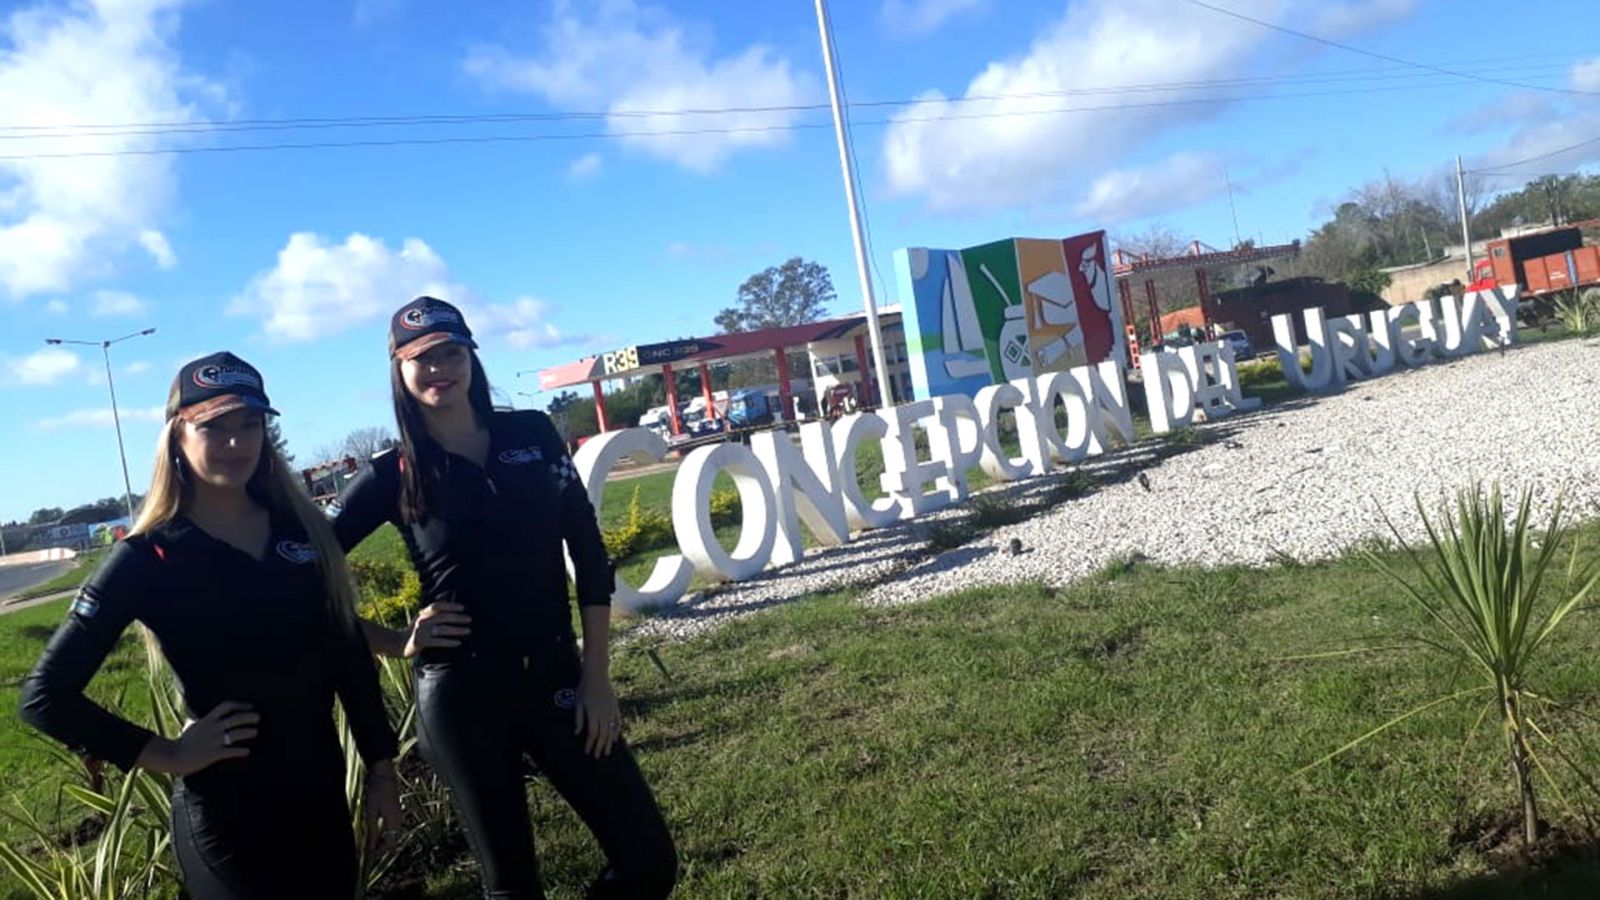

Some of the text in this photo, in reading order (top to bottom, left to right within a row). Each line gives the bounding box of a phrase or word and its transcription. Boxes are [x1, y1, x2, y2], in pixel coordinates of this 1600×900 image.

[563, 285, 1522, 615] CONCEPCION DEL URUGUAY
[604, 347, 640, 375] R39
